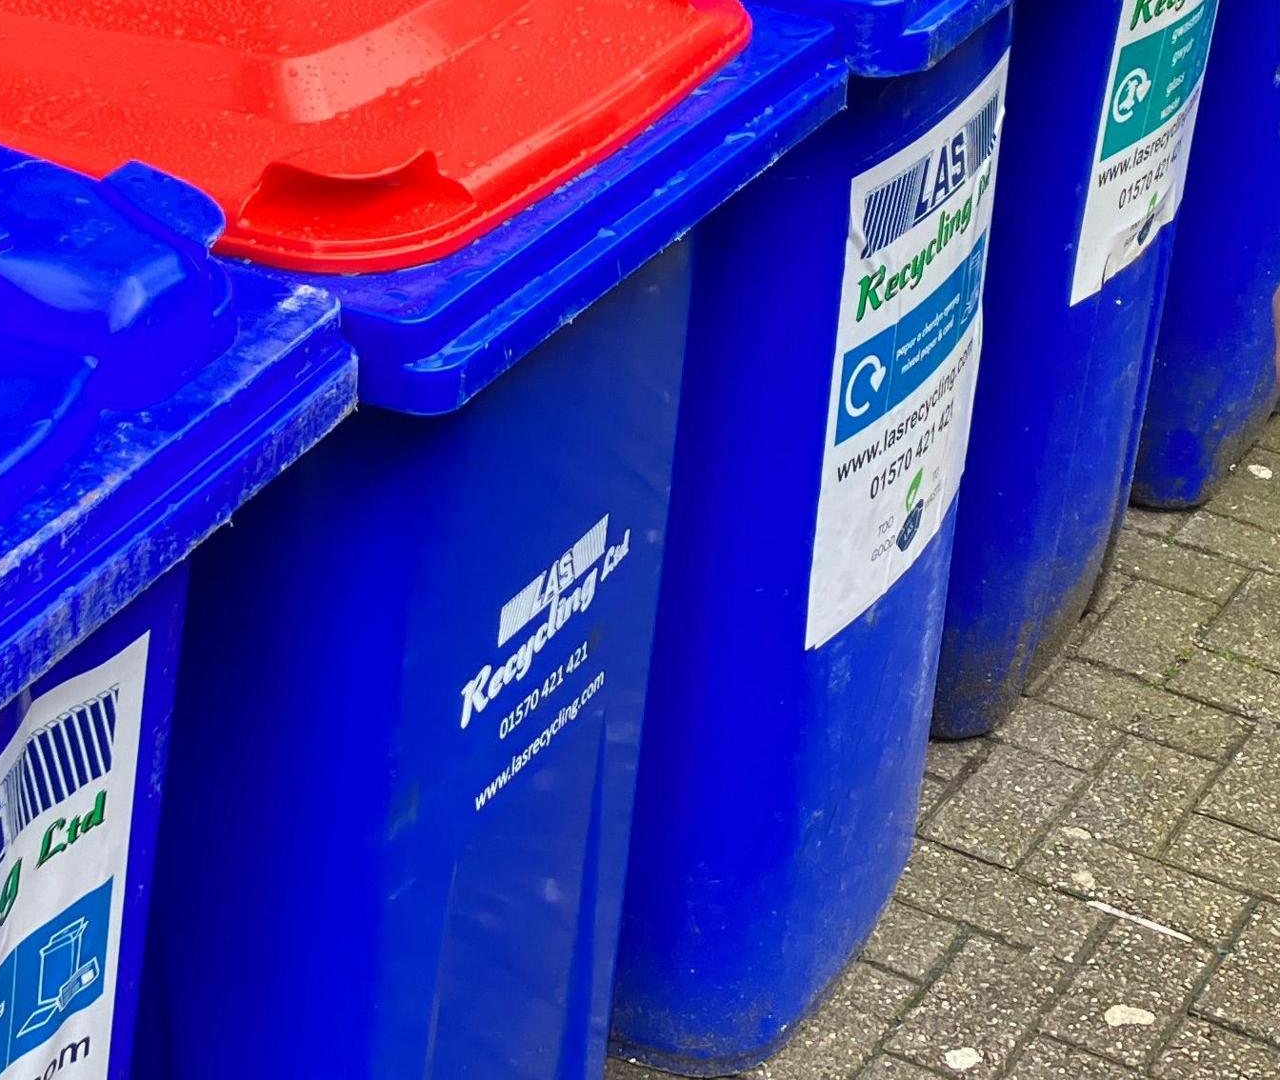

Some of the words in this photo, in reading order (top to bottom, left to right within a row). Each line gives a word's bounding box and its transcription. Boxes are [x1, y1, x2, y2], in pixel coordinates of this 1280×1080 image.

[914, 130, 966, 220] LAS
[1119, 169, 1153, 210] 01570
[856, 195, 973, 323] Recycling
[837, 338, 974, 483] www.lasrecycling.com
[871, 447, 913, 499] 01570
[915, 422, 936, 458] 421
[937, 398, 955, 433] 421
[531, 548, 574, 614] LAS
[461, 567, 598, 730] Recycling
[499, 687, 540, 740] 01570
[540, 665, 564, 699] 421
[565, 641, 589, 675] 421
[475, 671, 605, 811] www.lasrecycling.com
[34, 789, 107, 870] Ltd
